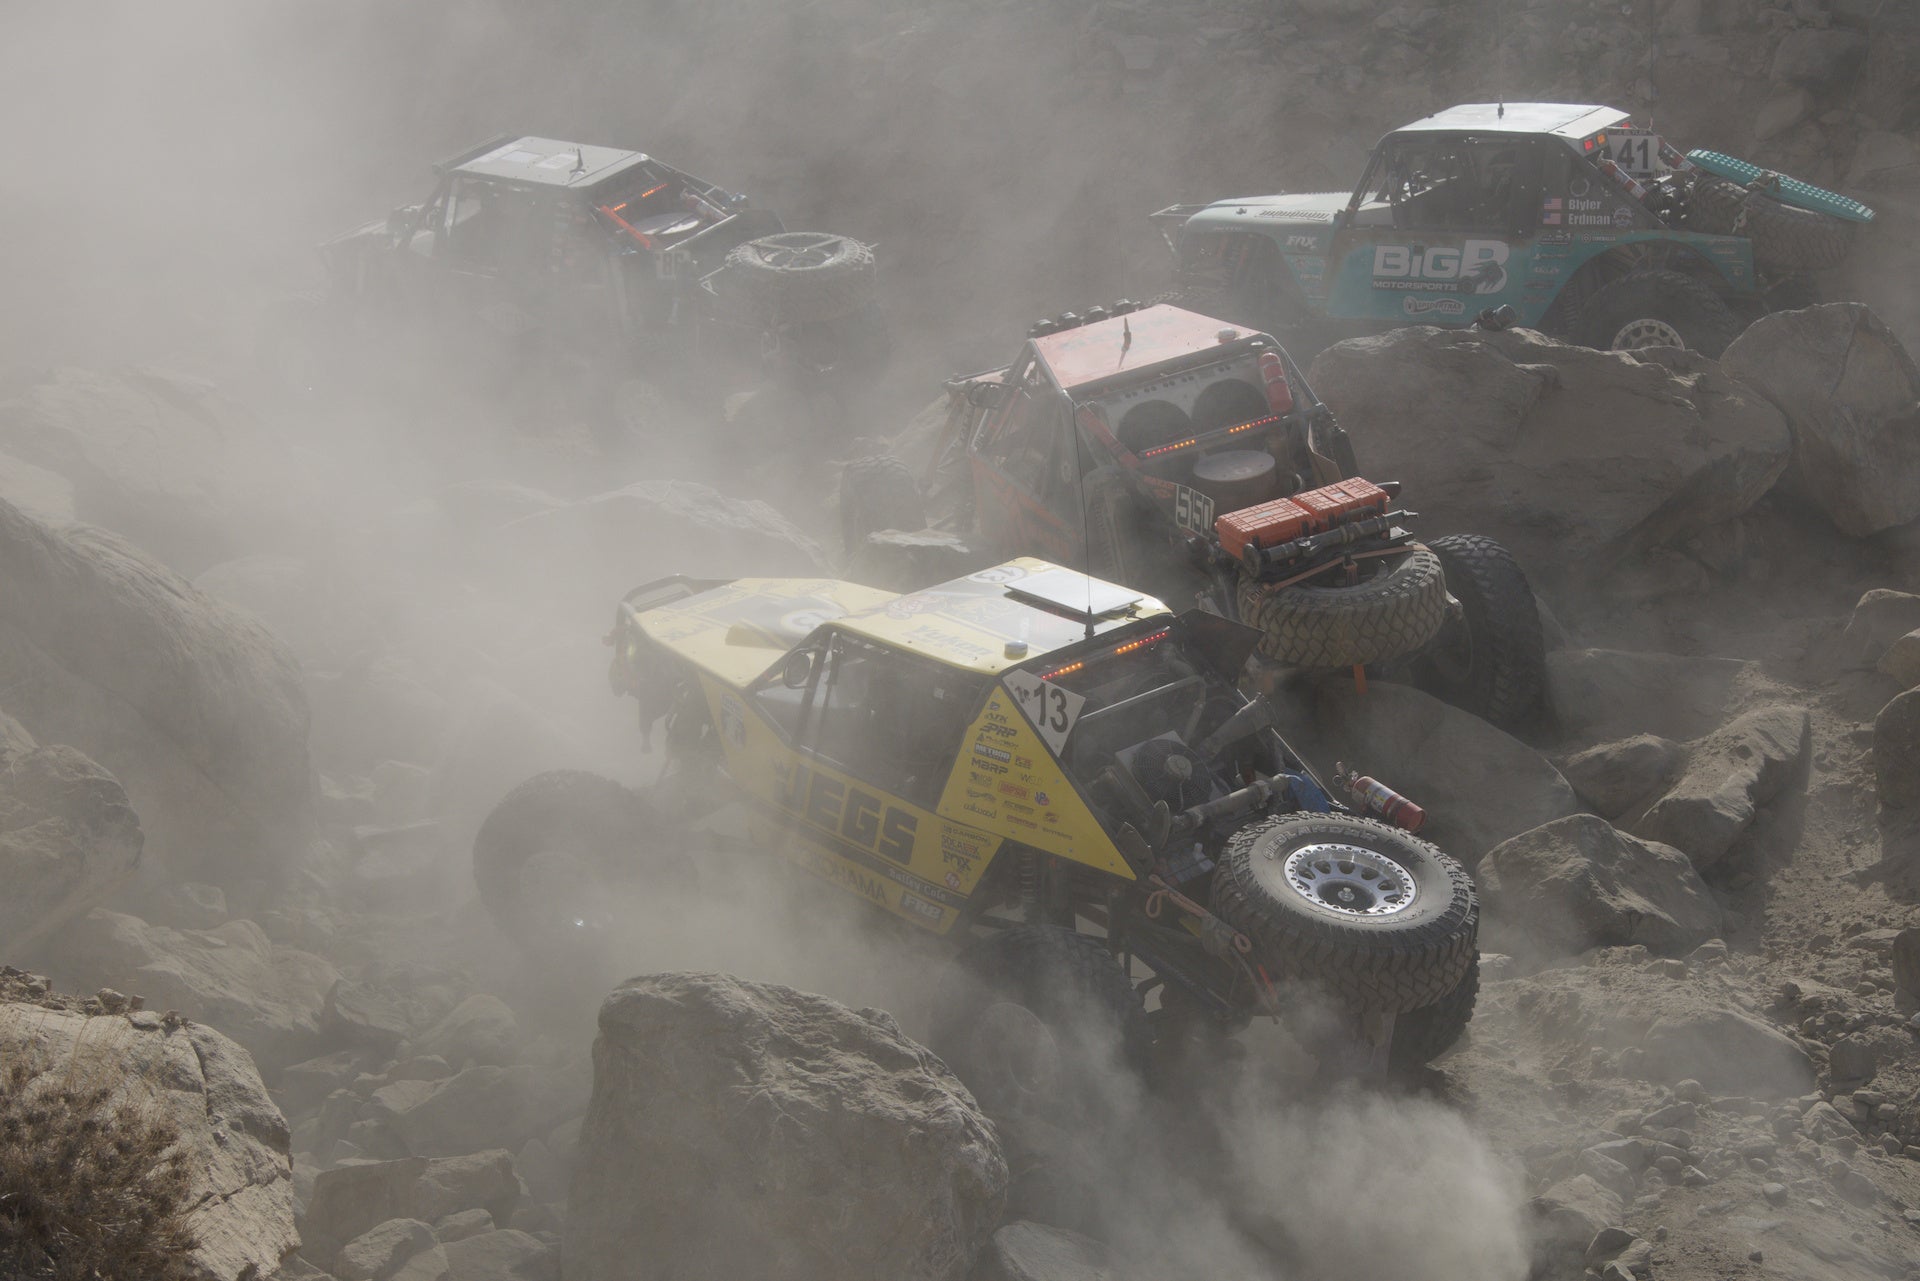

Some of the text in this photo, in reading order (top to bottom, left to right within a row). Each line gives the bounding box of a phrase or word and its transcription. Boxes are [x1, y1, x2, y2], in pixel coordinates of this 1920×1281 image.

[1617, 138, 1649, 169] 41
[1568, 199, 1602, 211] Blyler
[1568, 213, 1611, 225] Erdman
[1373, 281, 1458, 292] MOTORSPORTS
[1034, 682, 1069, 733] 13
[980, 722, 1018, 738] PRP
[971, 757, 1009, 774] MBRP
